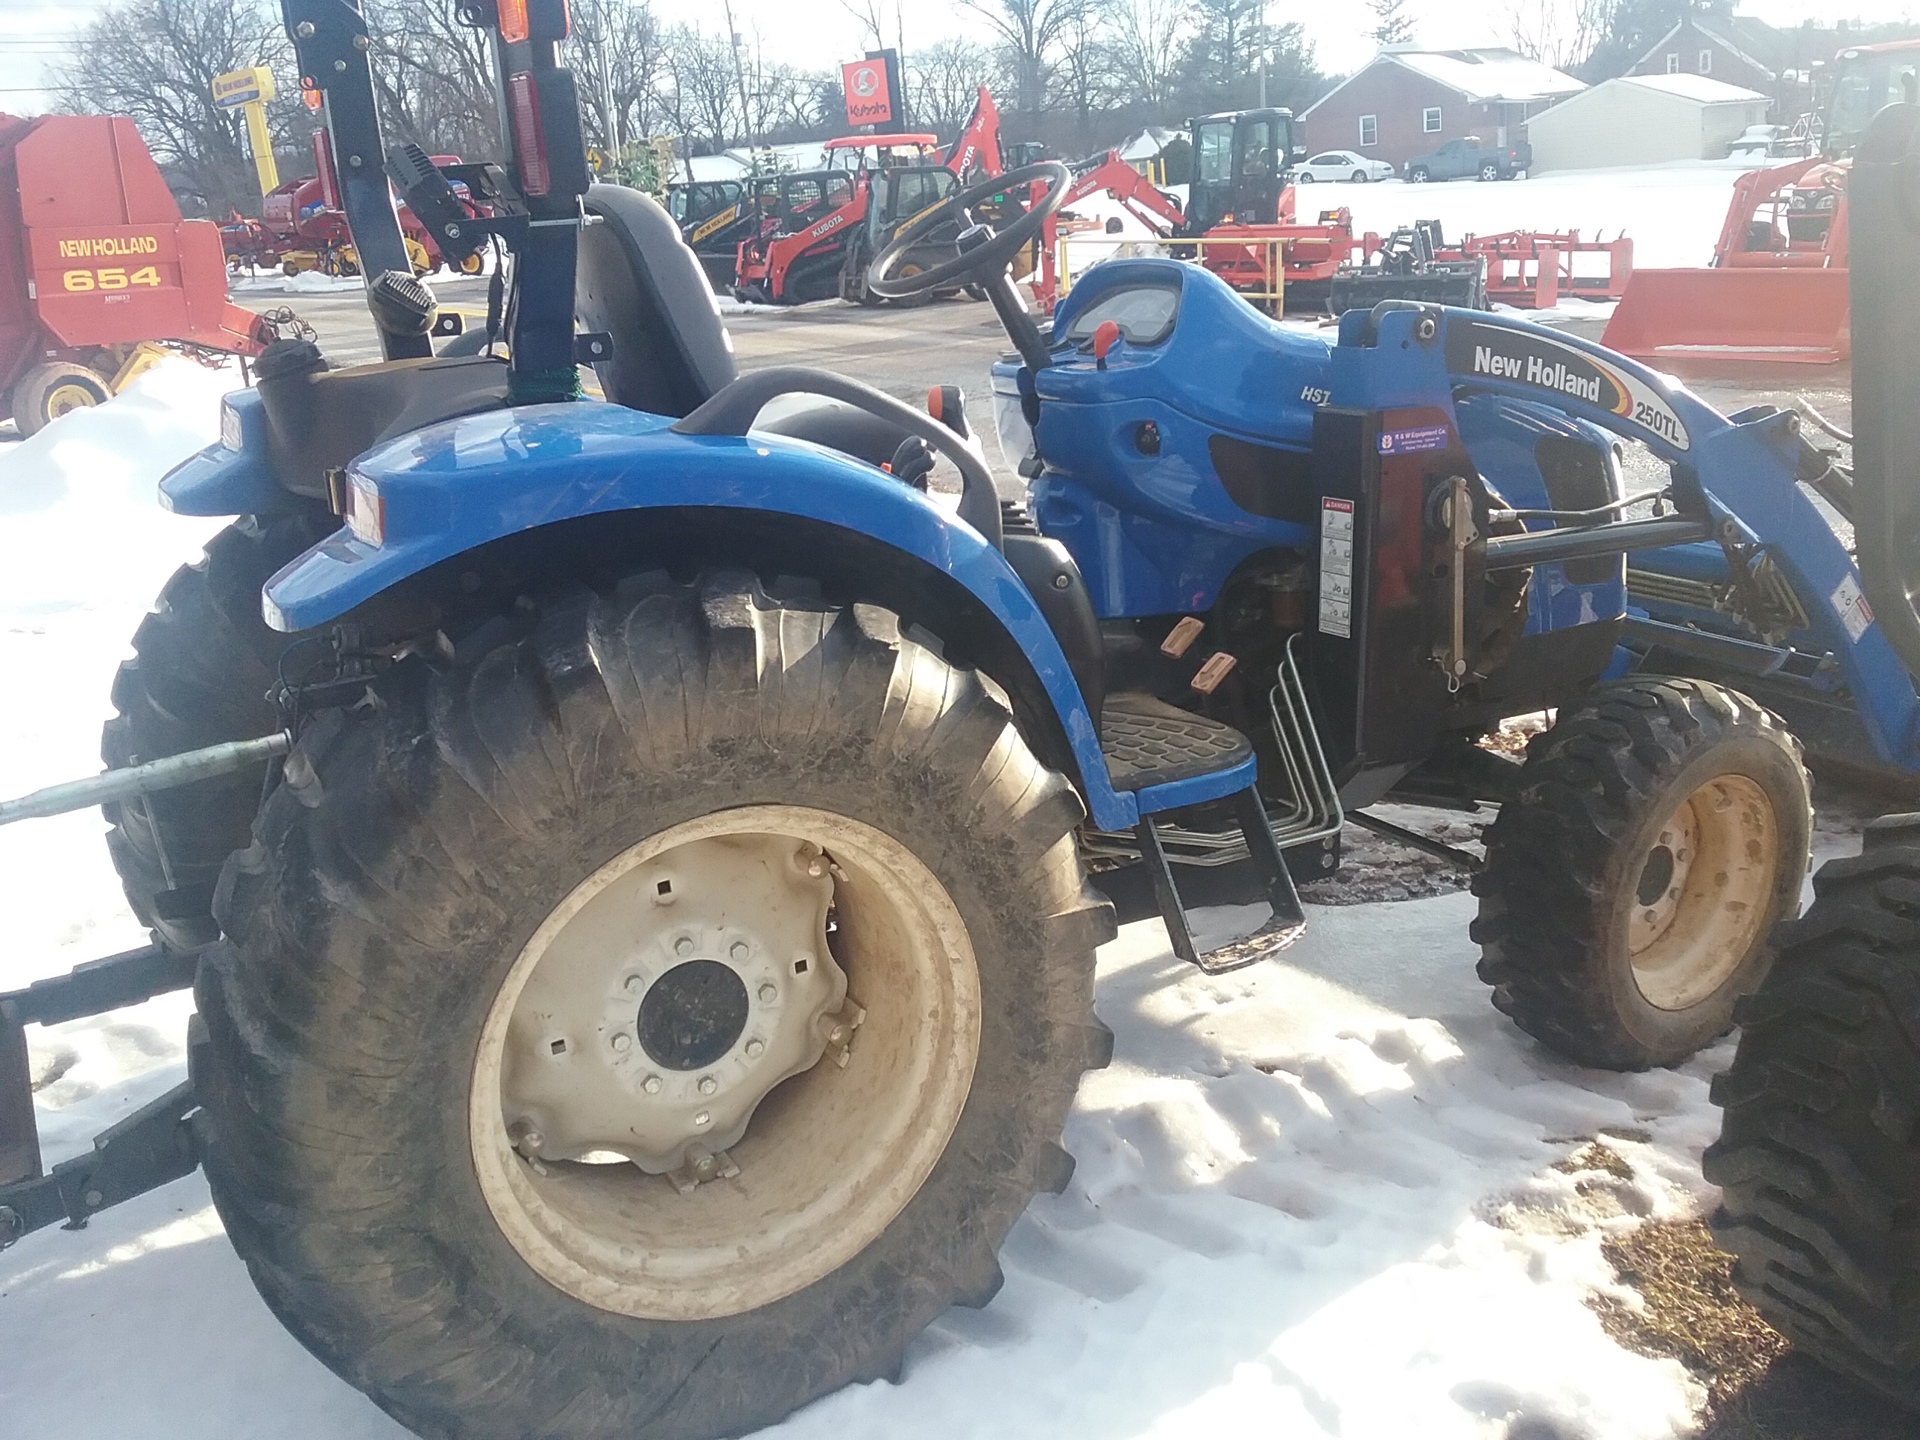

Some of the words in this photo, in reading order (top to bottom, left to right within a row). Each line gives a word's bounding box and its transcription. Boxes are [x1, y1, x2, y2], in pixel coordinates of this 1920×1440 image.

[850, 102, 887, 117] Kubota
[812, 215, 844, 238] KUBOTA
[59, 239, 92, 258] NEW
[92, 236, 158, 256] HOLLAND
[63, 266, 161, 292] 654
[1474, 345, 1522, 379] New
[1527, 355, 1601, 403] Holland
[1300, 386, 1331, 406] HST
[1635, 401, 1680, 442] 250TL
[1330, 501, 1351, 510] DANGER
